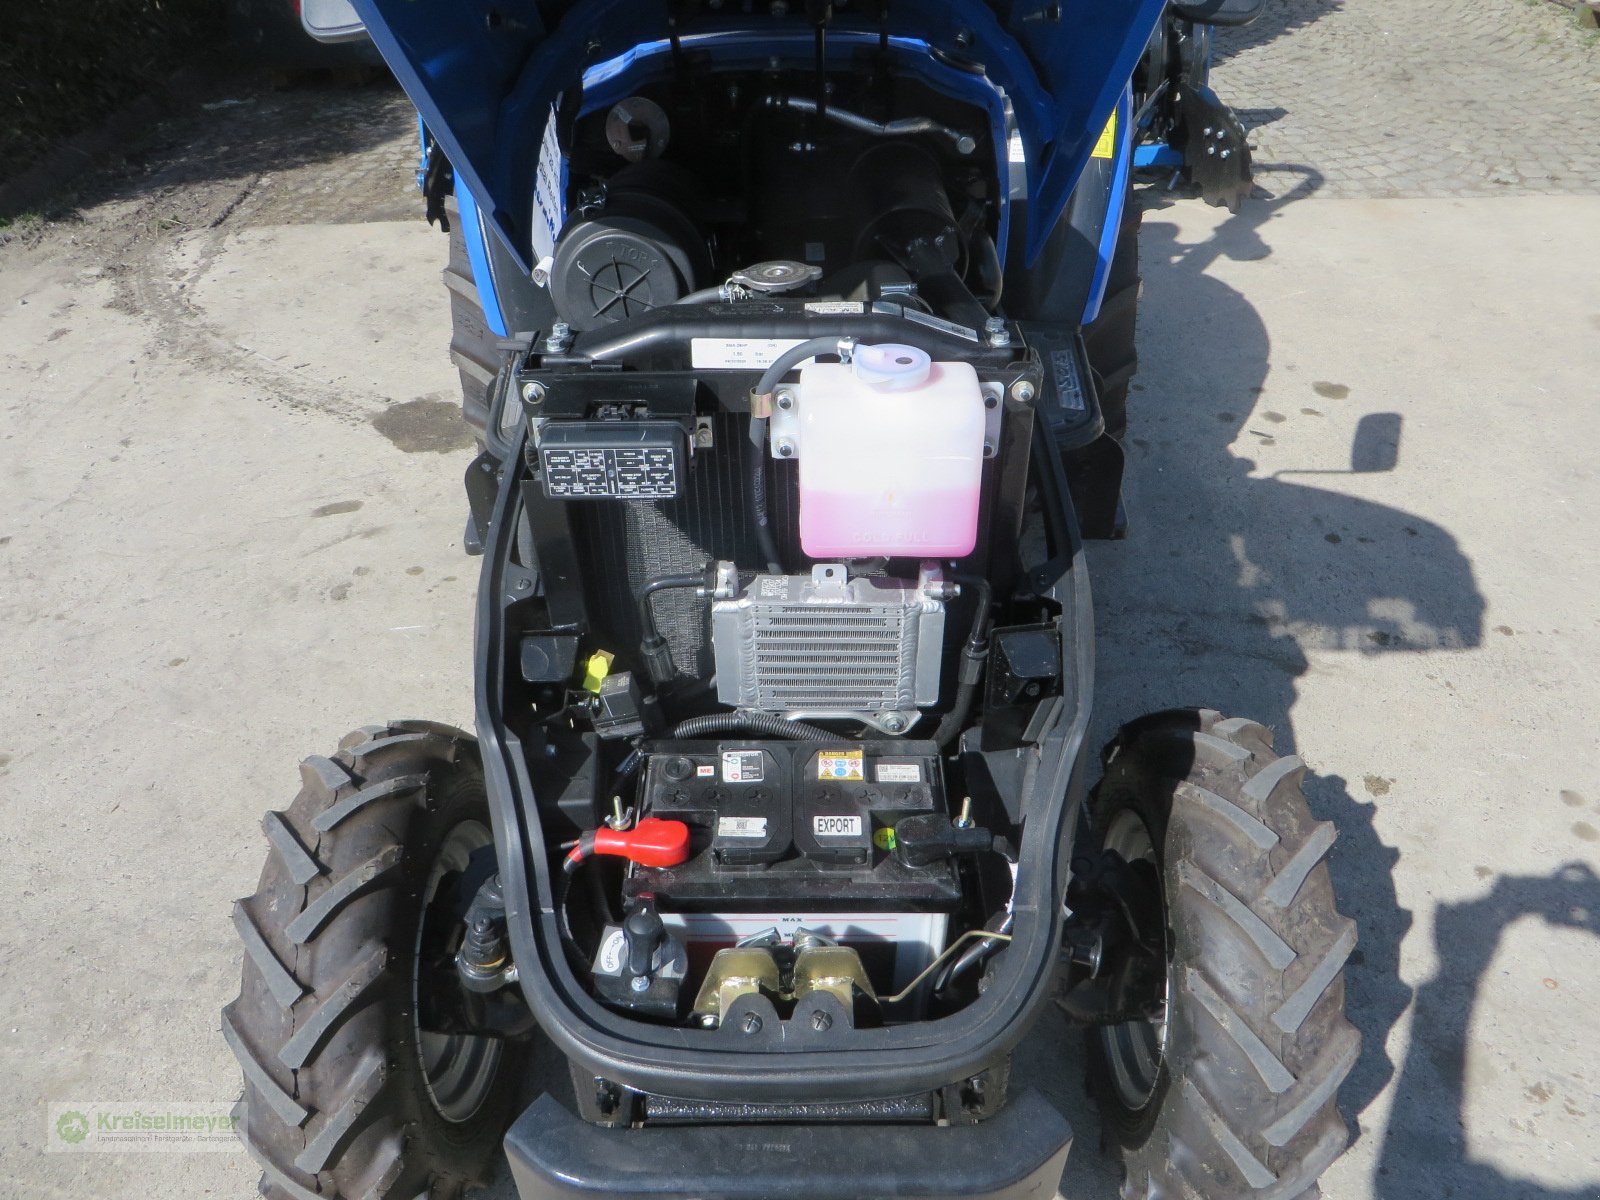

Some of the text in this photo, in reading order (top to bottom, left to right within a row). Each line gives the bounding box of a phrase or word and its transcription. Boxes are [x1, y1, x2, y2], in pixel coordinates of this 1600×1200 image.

[620, 242, 650, 263] TOP
[895, 531, 929, 543] FULL
[818, 818, 854, 833] EXPORT
[605, 955, 614, 968] OFF
